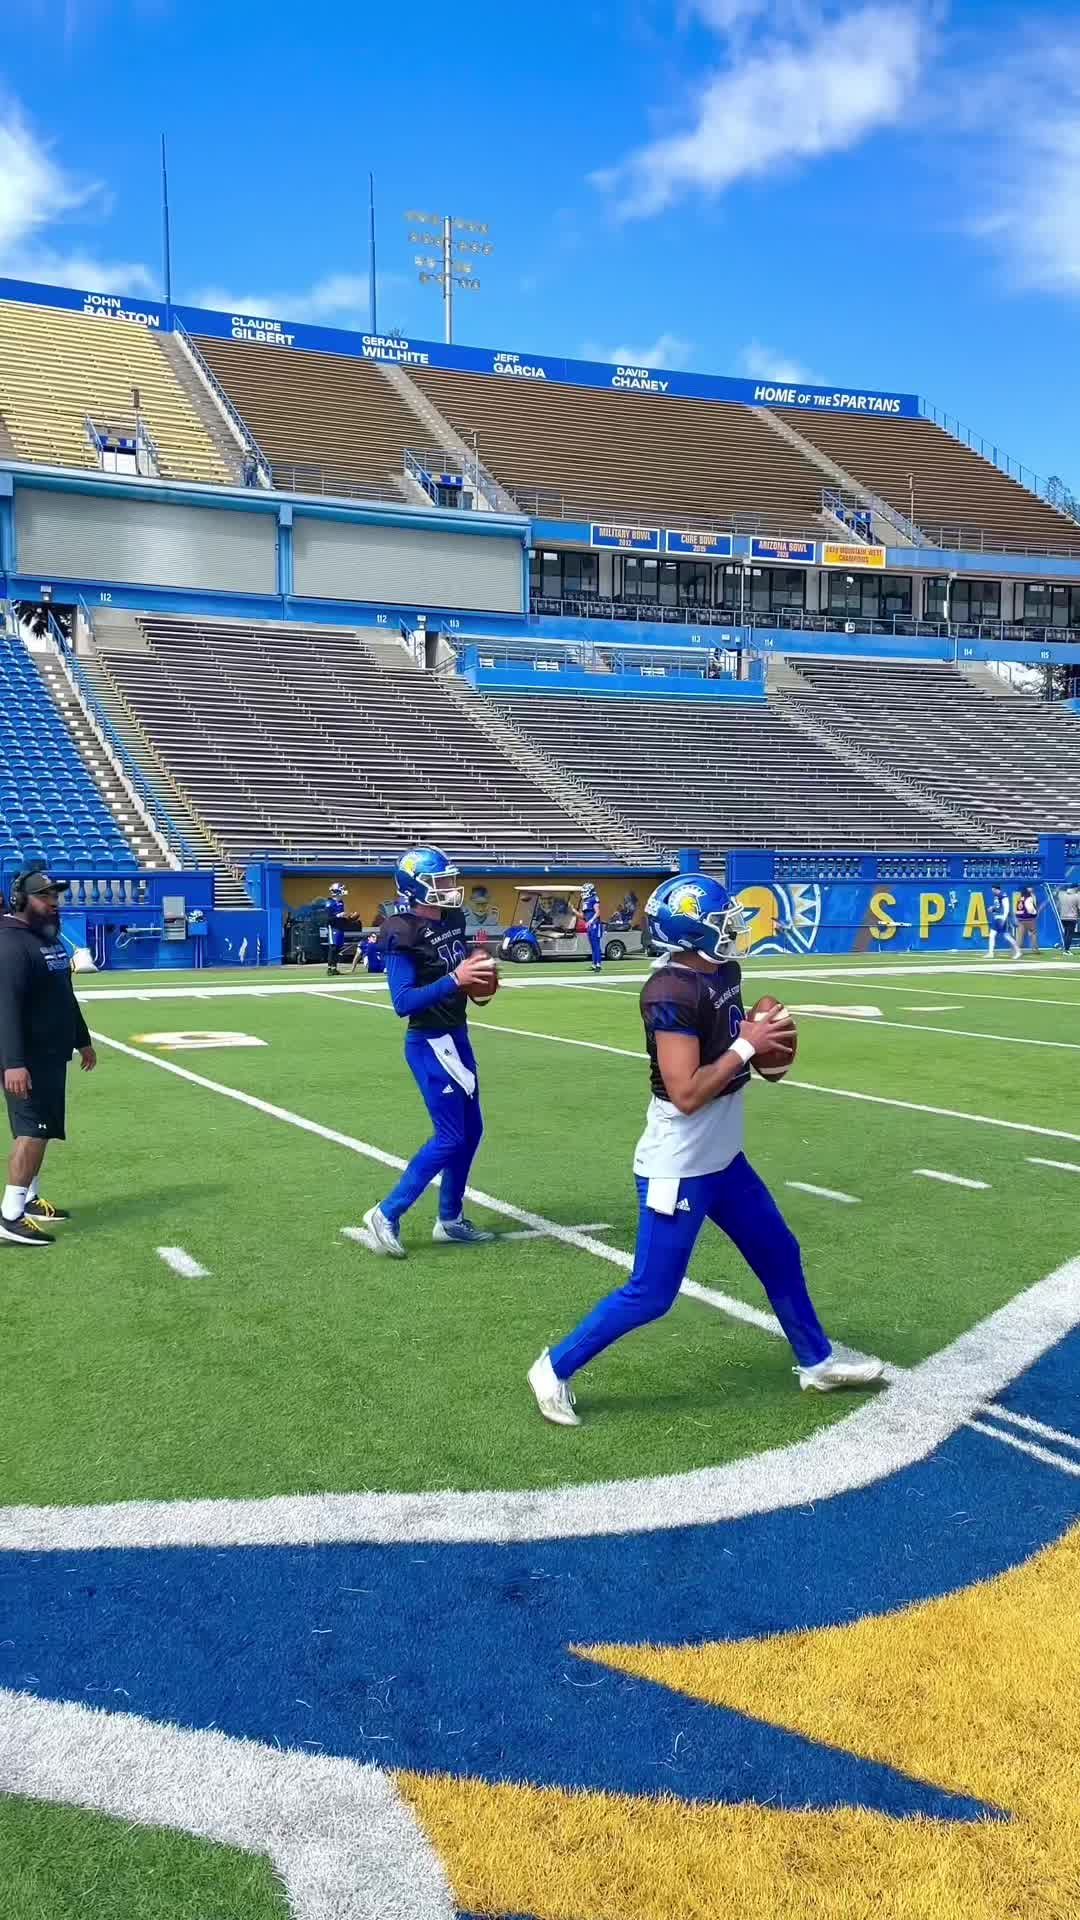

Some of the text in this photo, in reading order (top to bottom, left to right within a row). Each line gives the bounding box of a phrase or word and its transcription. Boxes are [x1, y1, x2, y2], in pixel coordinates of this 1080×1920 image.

[84, 295, 121, 308] JOHN
[83, 305, 160, 327] RALSTON
[232, 317, 281, 332] CLAUDE
[231, 327, 295, 345] GILBERT
[362, 336, 409, 349] GERALD
[362, 345, 429, 364] WILLHITE
[494, 353, 519, 363] JEFF
[493, 363, 546, 379] GARCIA
[616, 367, 649, 378] DAVID
[612, 376, 669, 392] CHANEY
[754, 386, 900, 412] HOME OF THE SPARTANS
[599, 527, 652, 541] MILITARY BOWL
[680, 534, 718, 546] CURE BOWL
[758, 540, 808, 553] ARIZONA BOWL
[100, 592, 112, 601] 112
[376, 614, 387, 623] 112
[449, 618, 460, 628] 113
